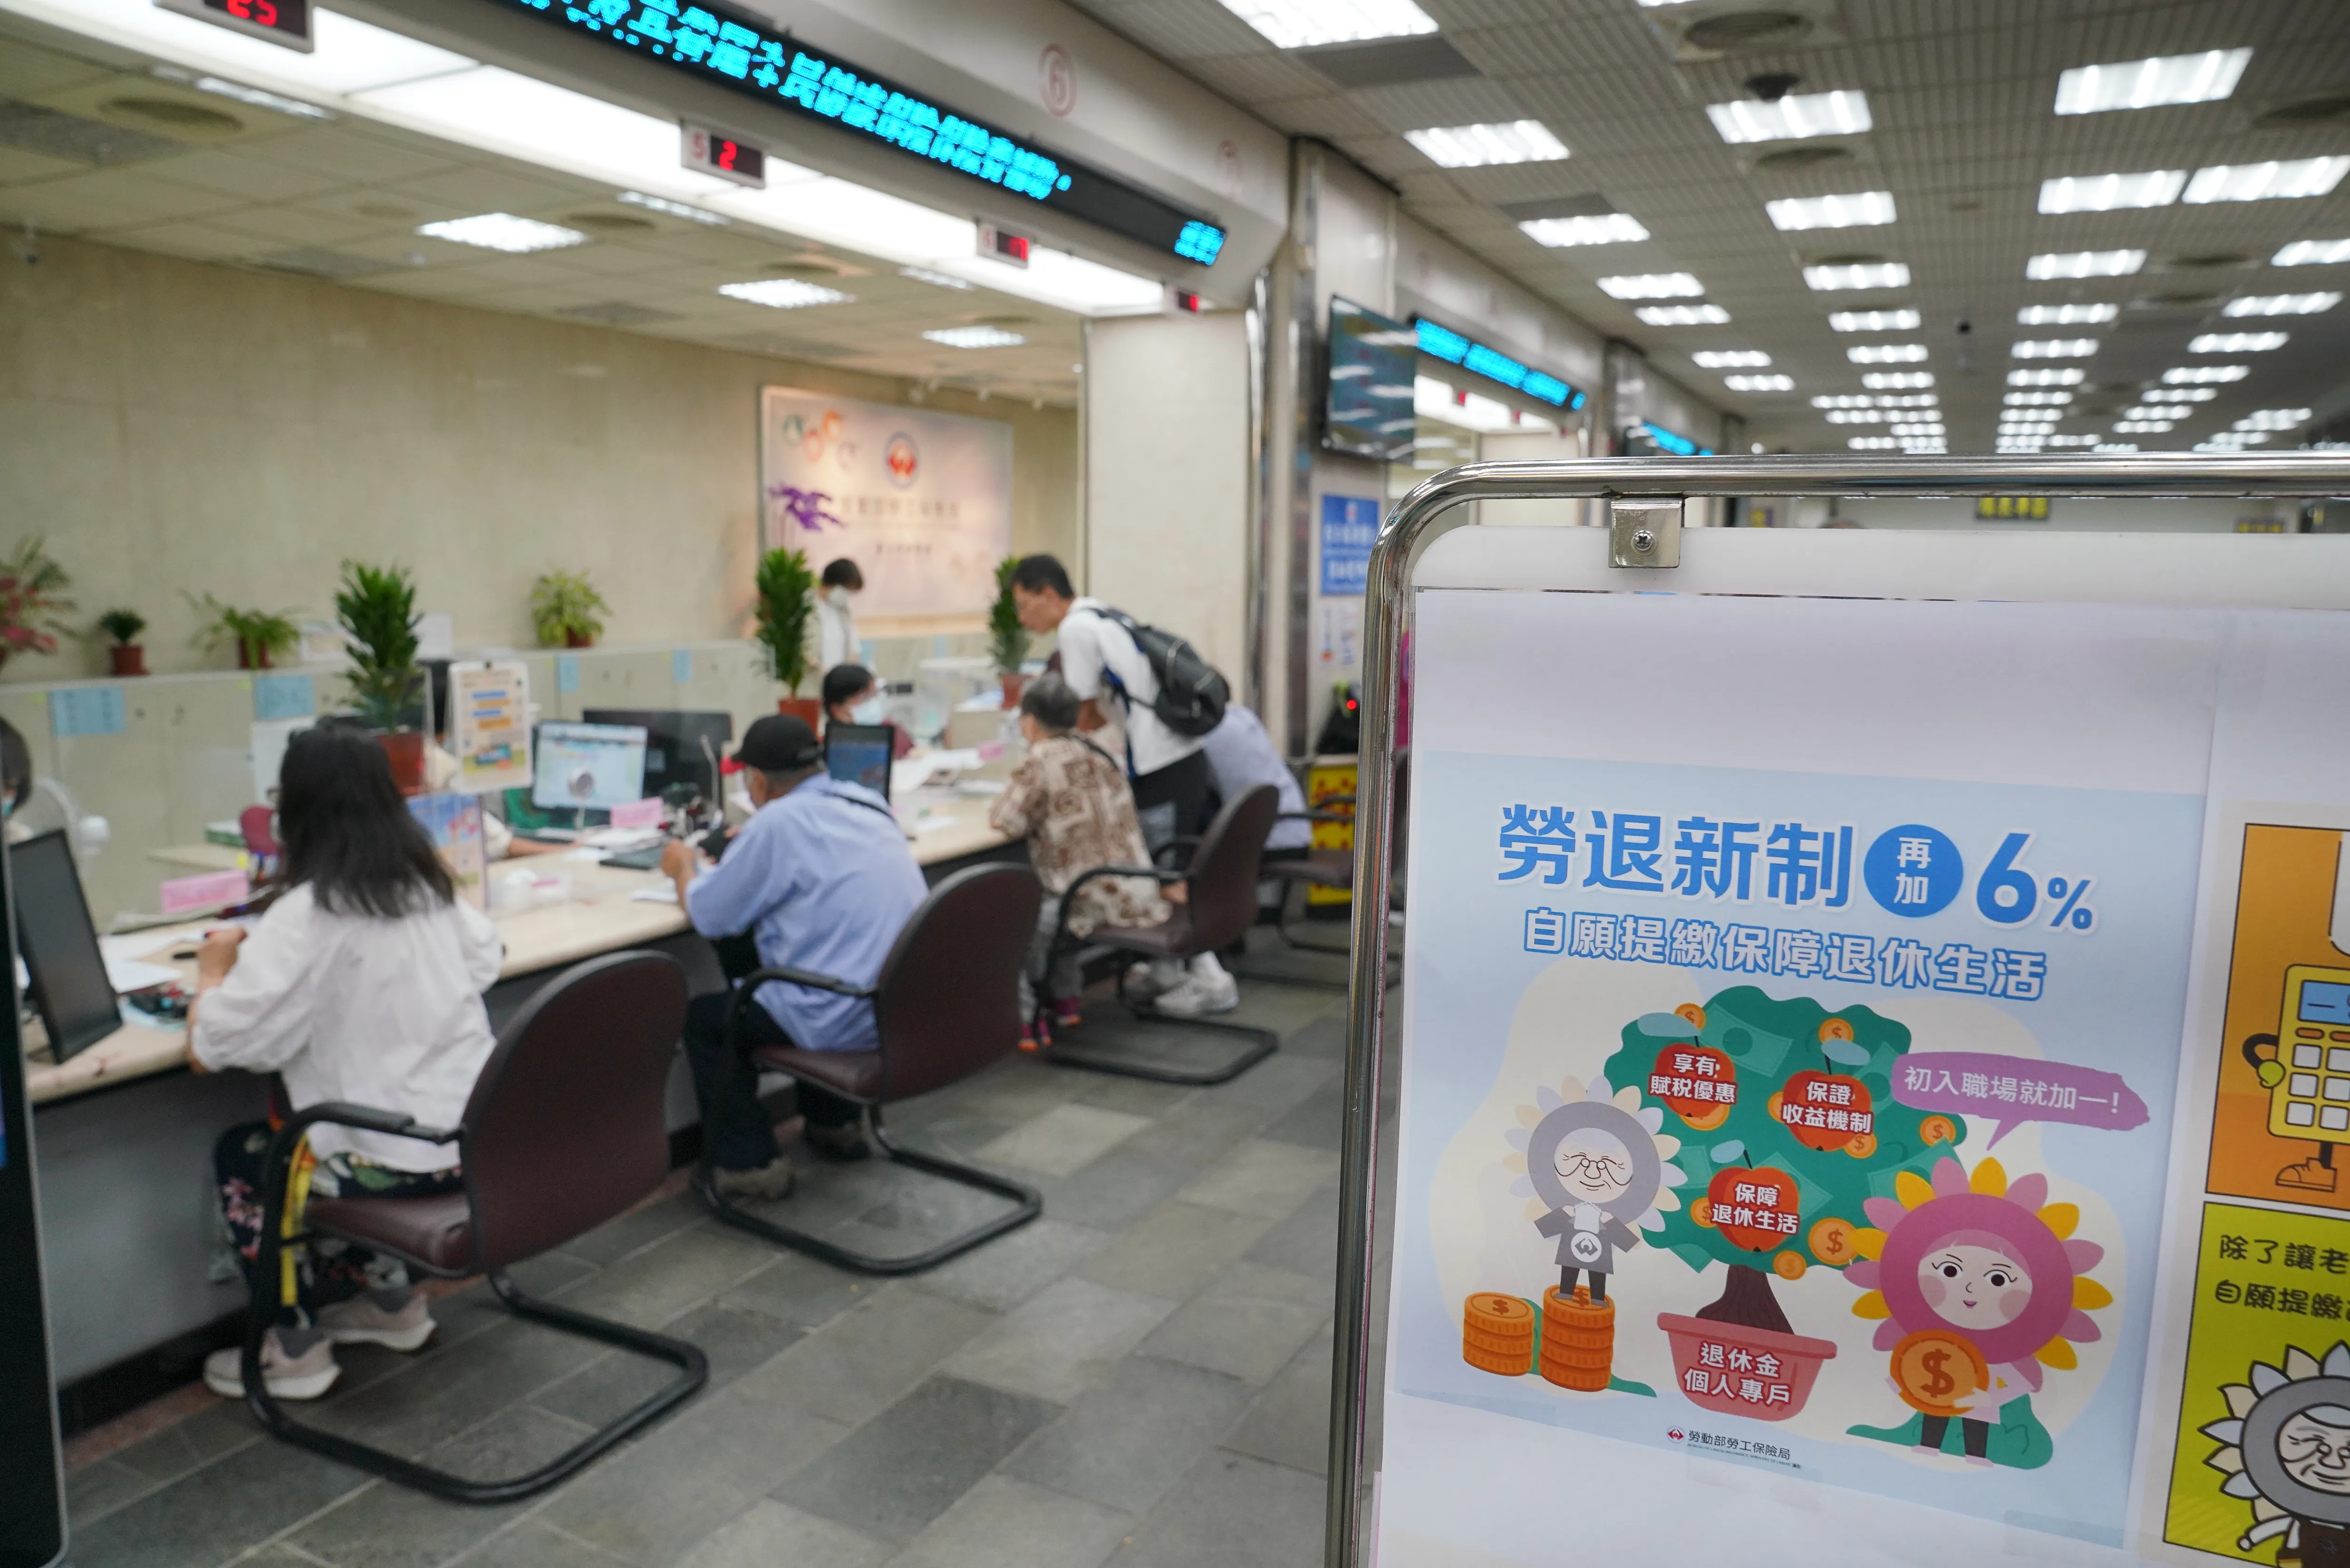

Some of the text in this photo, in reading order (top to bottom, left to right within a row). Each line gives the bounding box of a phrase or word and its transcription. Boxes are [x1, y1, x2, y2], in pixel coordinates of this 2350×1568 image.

[719, 140, 737, 170] 2
[1497, 803, 2092, 930] 勞退新制 再加 6%
[1524, 906, 2047, 1002] 自願提繳保障退休生活
[1673, 1053, 1717, 1076] 享有
[1807, 1081, 1851, 1105] 保證
[1782, 1104, 1872, 1133] 收益機制
[1735, 1183, 1778, 1207] 保障
[1712, 1203, 1799, 1234] 退休生活
[2219, 1234, 2350, 1274] 除了讓老
[2215, 1279, 2350, 1322] 自願提繳
[1700, 1342, 1780, 1378] 退休金
[1684, 1368, 1790, 1405] 個人專戶
[1688, 1429, 1791, 1460] 勞動部勞工保險局
